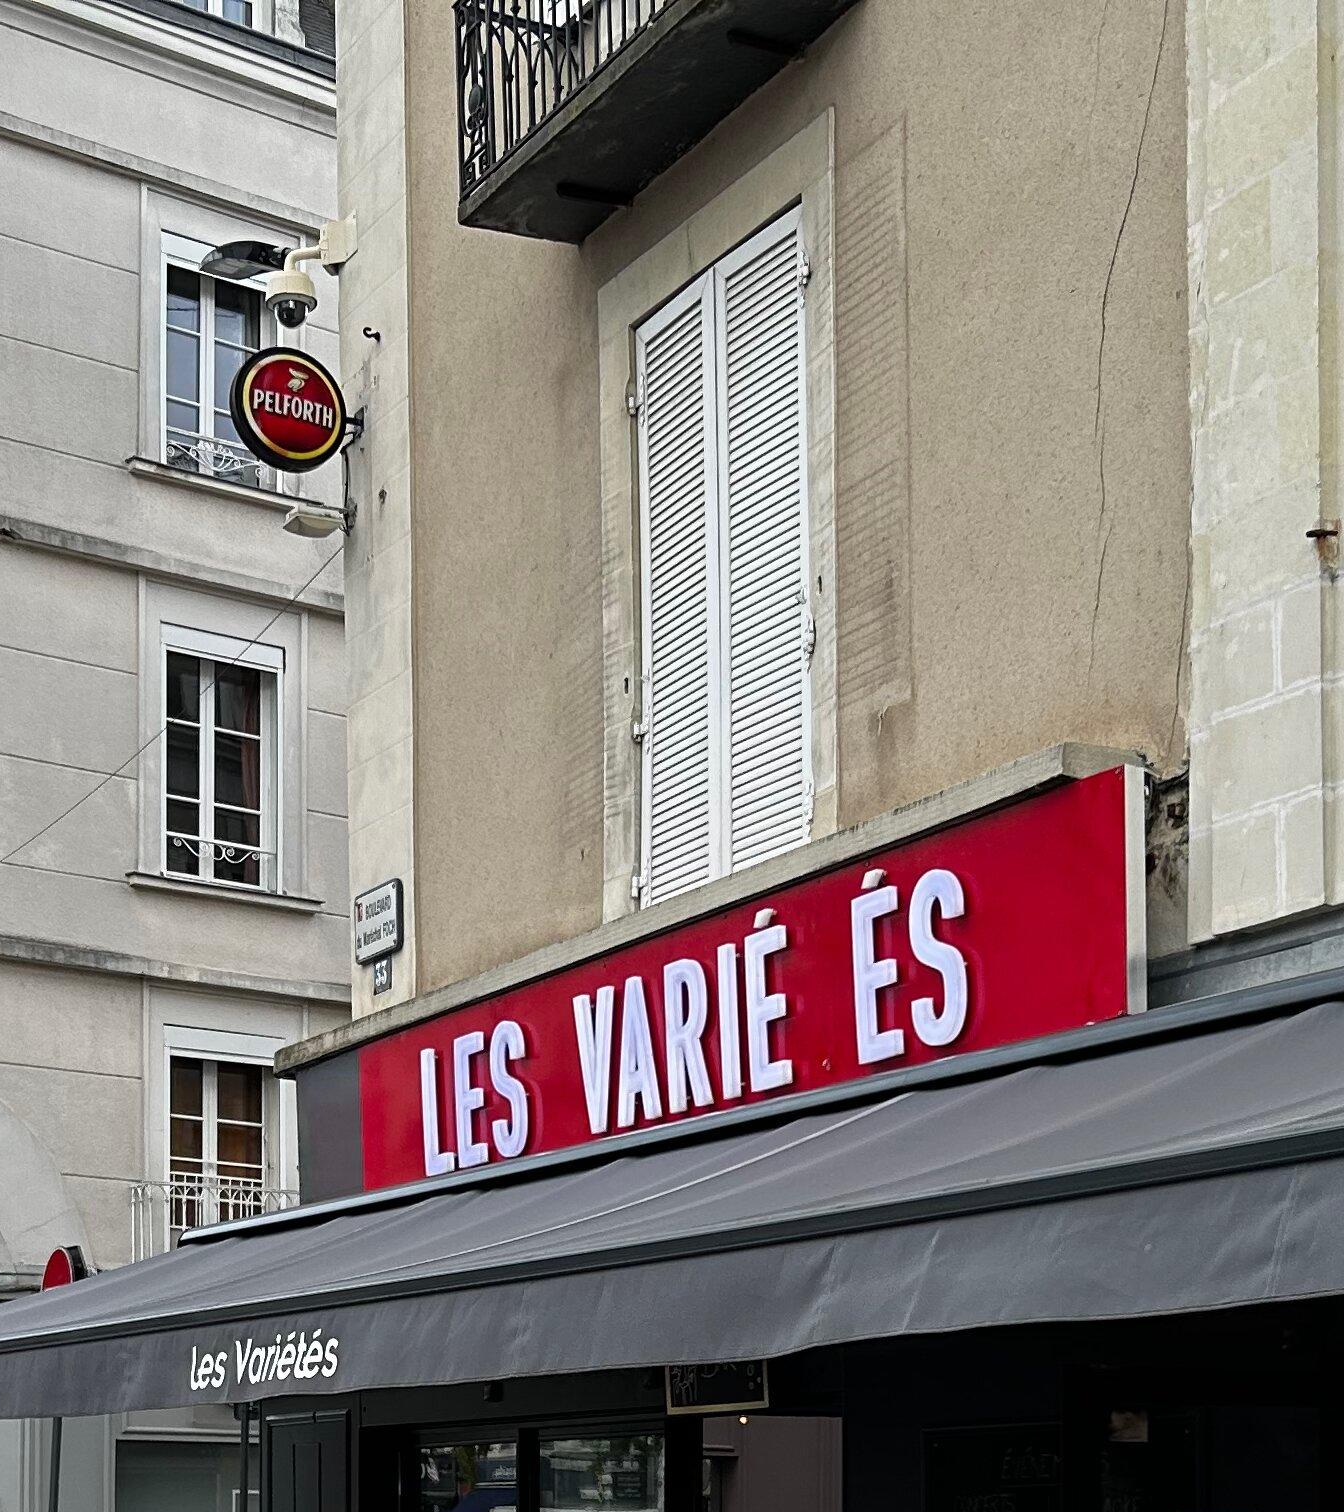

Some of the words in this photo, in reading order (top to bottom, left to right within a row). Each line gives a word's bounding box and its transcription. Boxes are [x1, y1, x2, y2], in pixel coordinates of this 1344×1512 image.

[253, 389, 333, 429] PELFORTH
[419, 1020, 529, 1177] LES
[235, 1328, 340, 1385] Variétés
